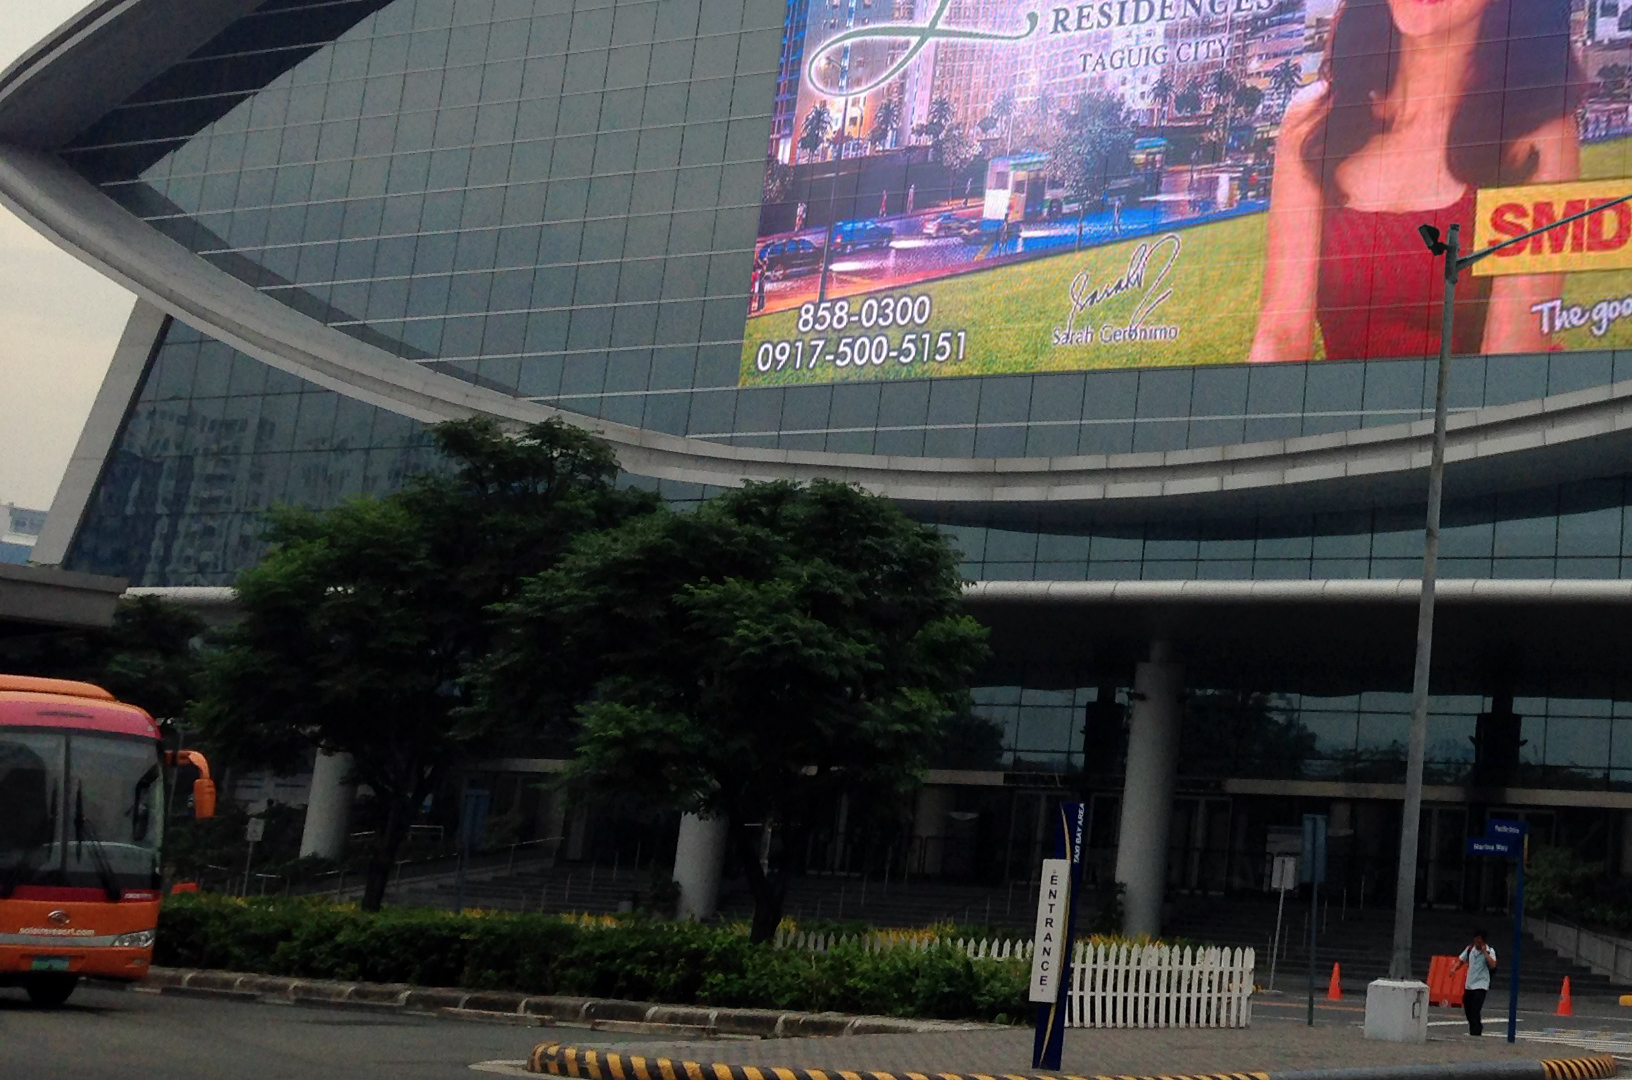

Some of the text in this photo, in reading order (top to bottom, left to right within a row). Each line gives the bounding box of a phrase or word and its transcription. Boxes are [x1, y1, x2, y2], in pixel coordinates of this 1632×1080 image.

[1079, 37, 1231, 73] TAGUIG CITY
[797, 294, 931, 333] 858-0300
[1531, 298, 1590, 335] The
[756, 330, 967, 372] 0917-500-5151
[1052, 323, 1180, 346] Sarah Geronimo
[1077, 803, 1085, 826] AREA
[1039, 874, 1059, 986] ENTRANCE
